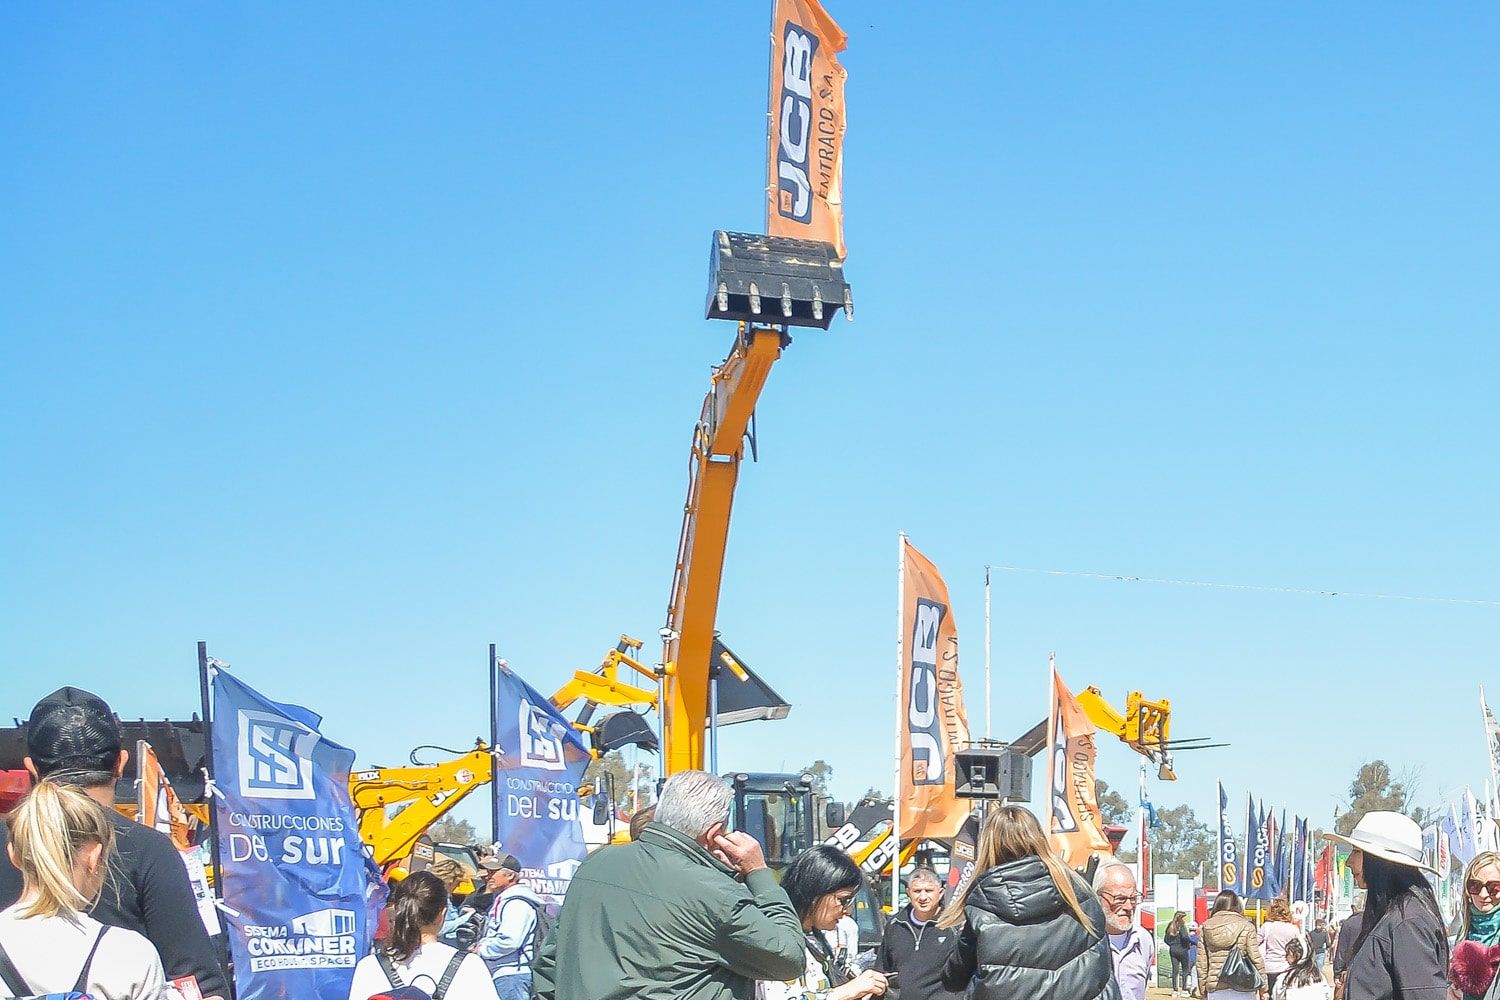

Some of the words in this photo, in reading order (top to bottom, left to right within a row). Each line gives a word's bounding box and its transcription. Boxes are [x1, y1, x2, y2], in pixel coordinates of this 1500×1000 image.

[780, 28, 812, 217] JCB
[818, 107, 836, 209] EMTRACO
[909, 603, 944, 781] JCB
[507, 777, 575, 794] CONSTRUCCIO
[823, 822, 861, 851] CB
